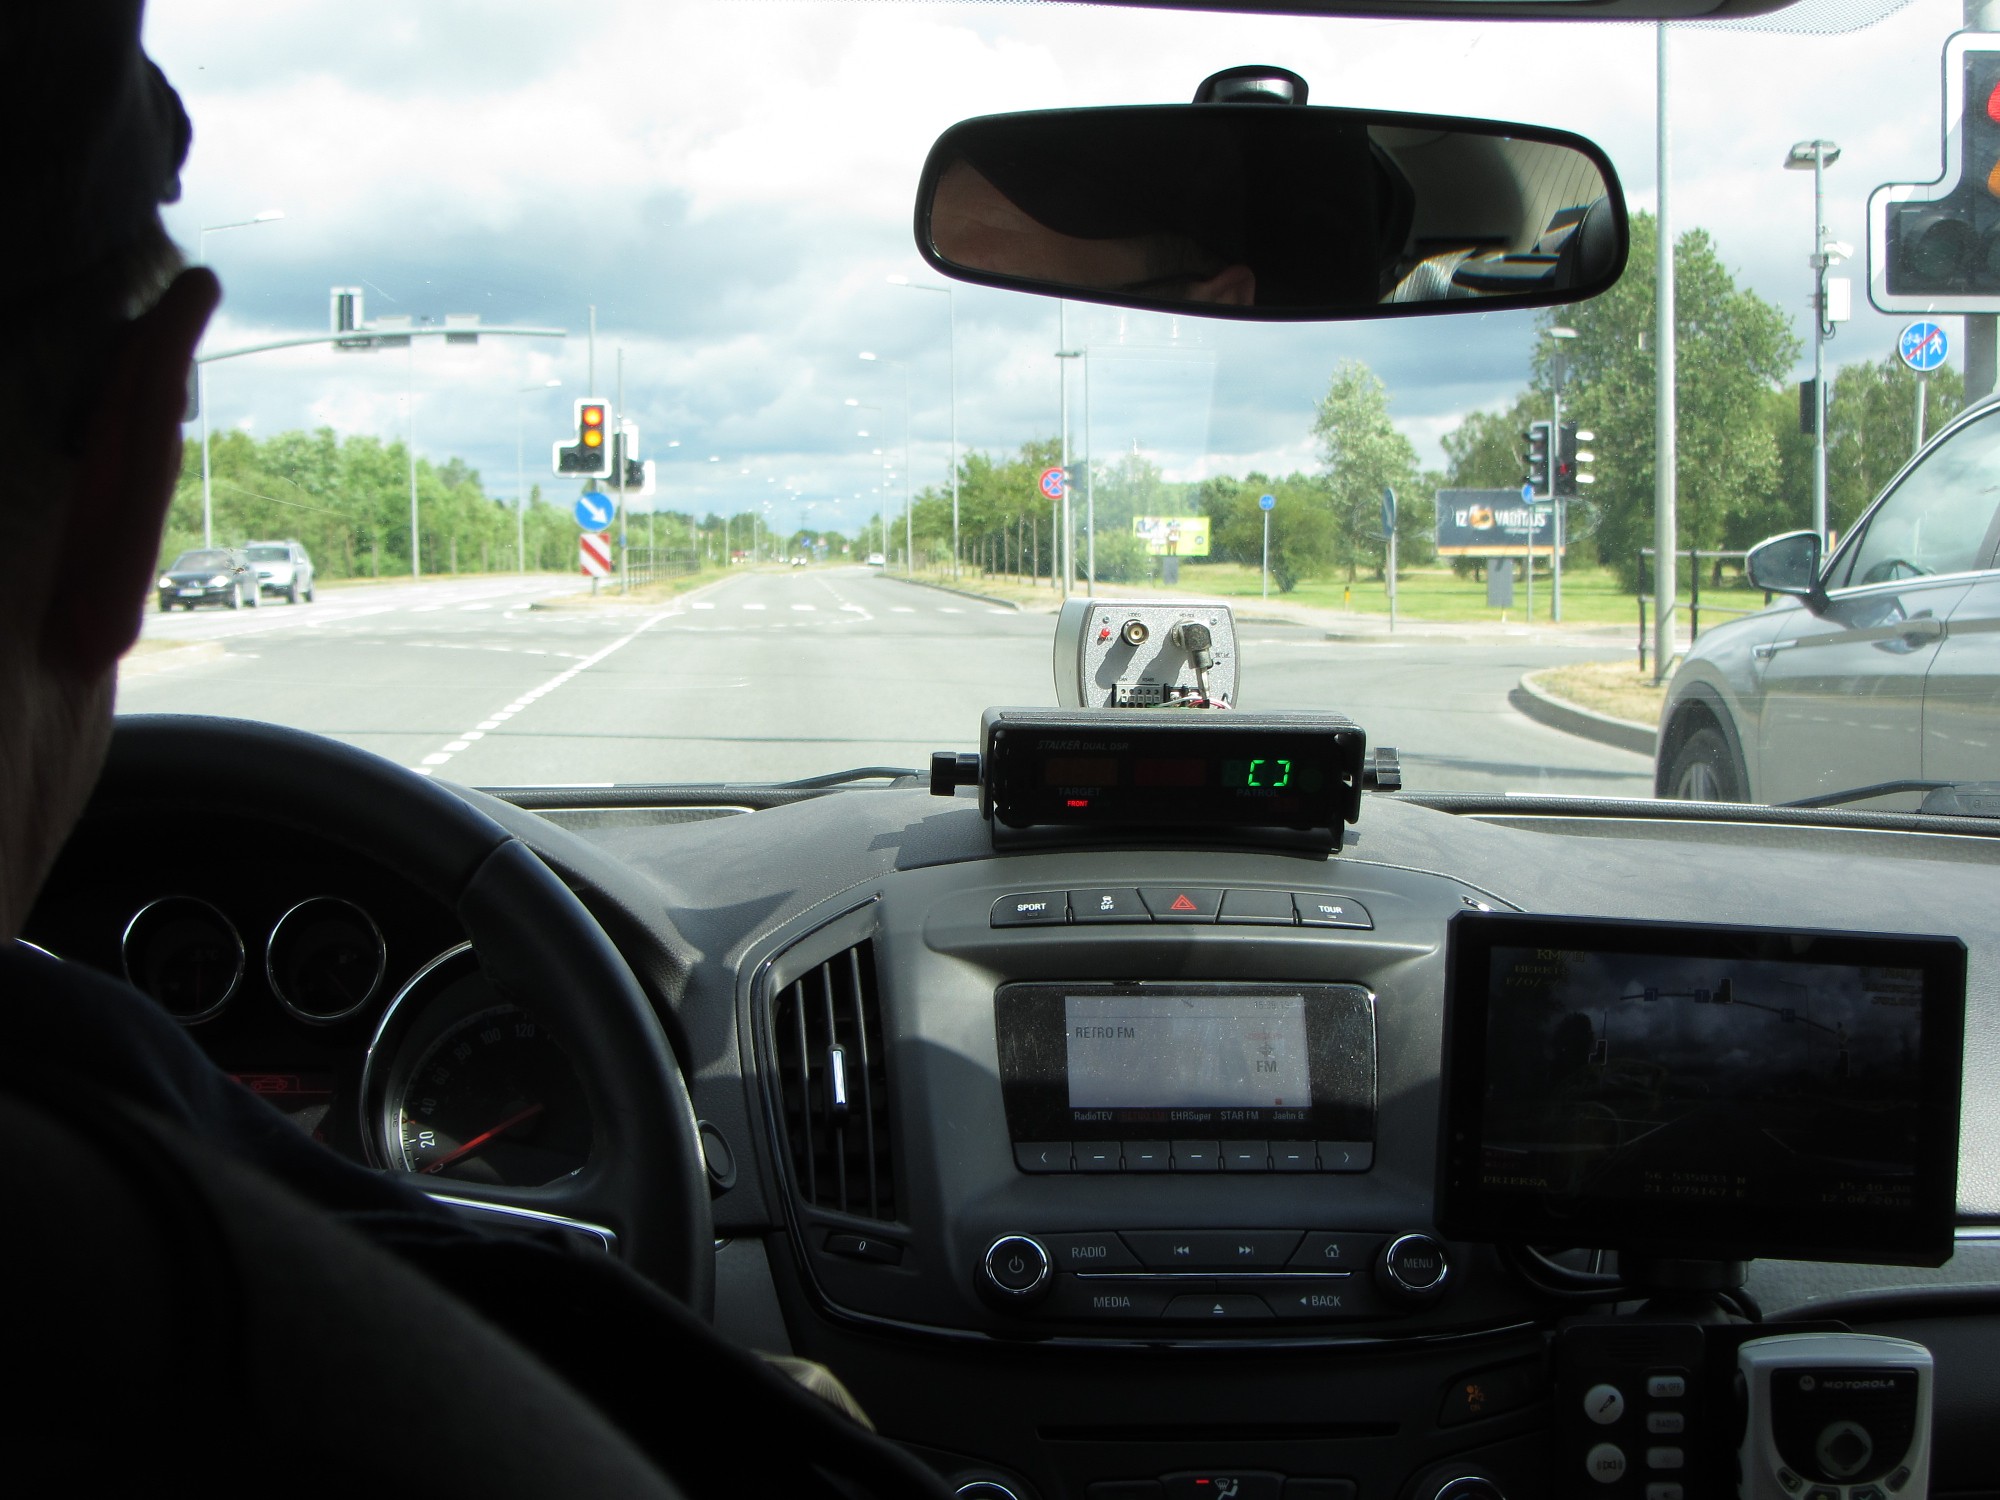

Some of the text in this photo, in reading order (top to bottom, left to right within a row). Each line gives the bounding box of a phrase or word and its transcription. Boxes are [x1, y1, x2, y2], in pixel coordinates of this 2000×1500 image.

[1037, 740, 1080, 751] STALKER
[1058, 786, 1101, 797] TARGET
[1236, 788, 1279, 798] PATROL
[1066, 800, 1089, 808] FRONT
[1017, 902, 1046, 912] SPORT
[1318, 904, 1343, 914] TOUR
[480, 1027, 501, 1045] 100
[515, 1023, 535, 1038] 120
[1075, 1026, 1135, 1039] RETRO FM
[454, 1042, 472, 1061] 80
[1256, 1060, 1277, 1073] FM
[420, 1097, 437, 1115] 40
[1074, 1111, 1113, 1121] RadioTEV
[1170, 1111, 1212, 1122] EHRSuper
[1220, 1111, 1259, 1120] STAR FM
[1272, 1111, 1296, 1120] Jaehn
[419, 1130, 436, 1149] 20
[1071, 1245, 1107, 1259] RADIO
[1403, 1256, 1434, 1269] MENU
[1093, 1295, 1131, 1308] MEDIA
[1311, 1294, 1342, 1308] BACK
[1822, 1379, 1896, 1390] MOTOROLA
